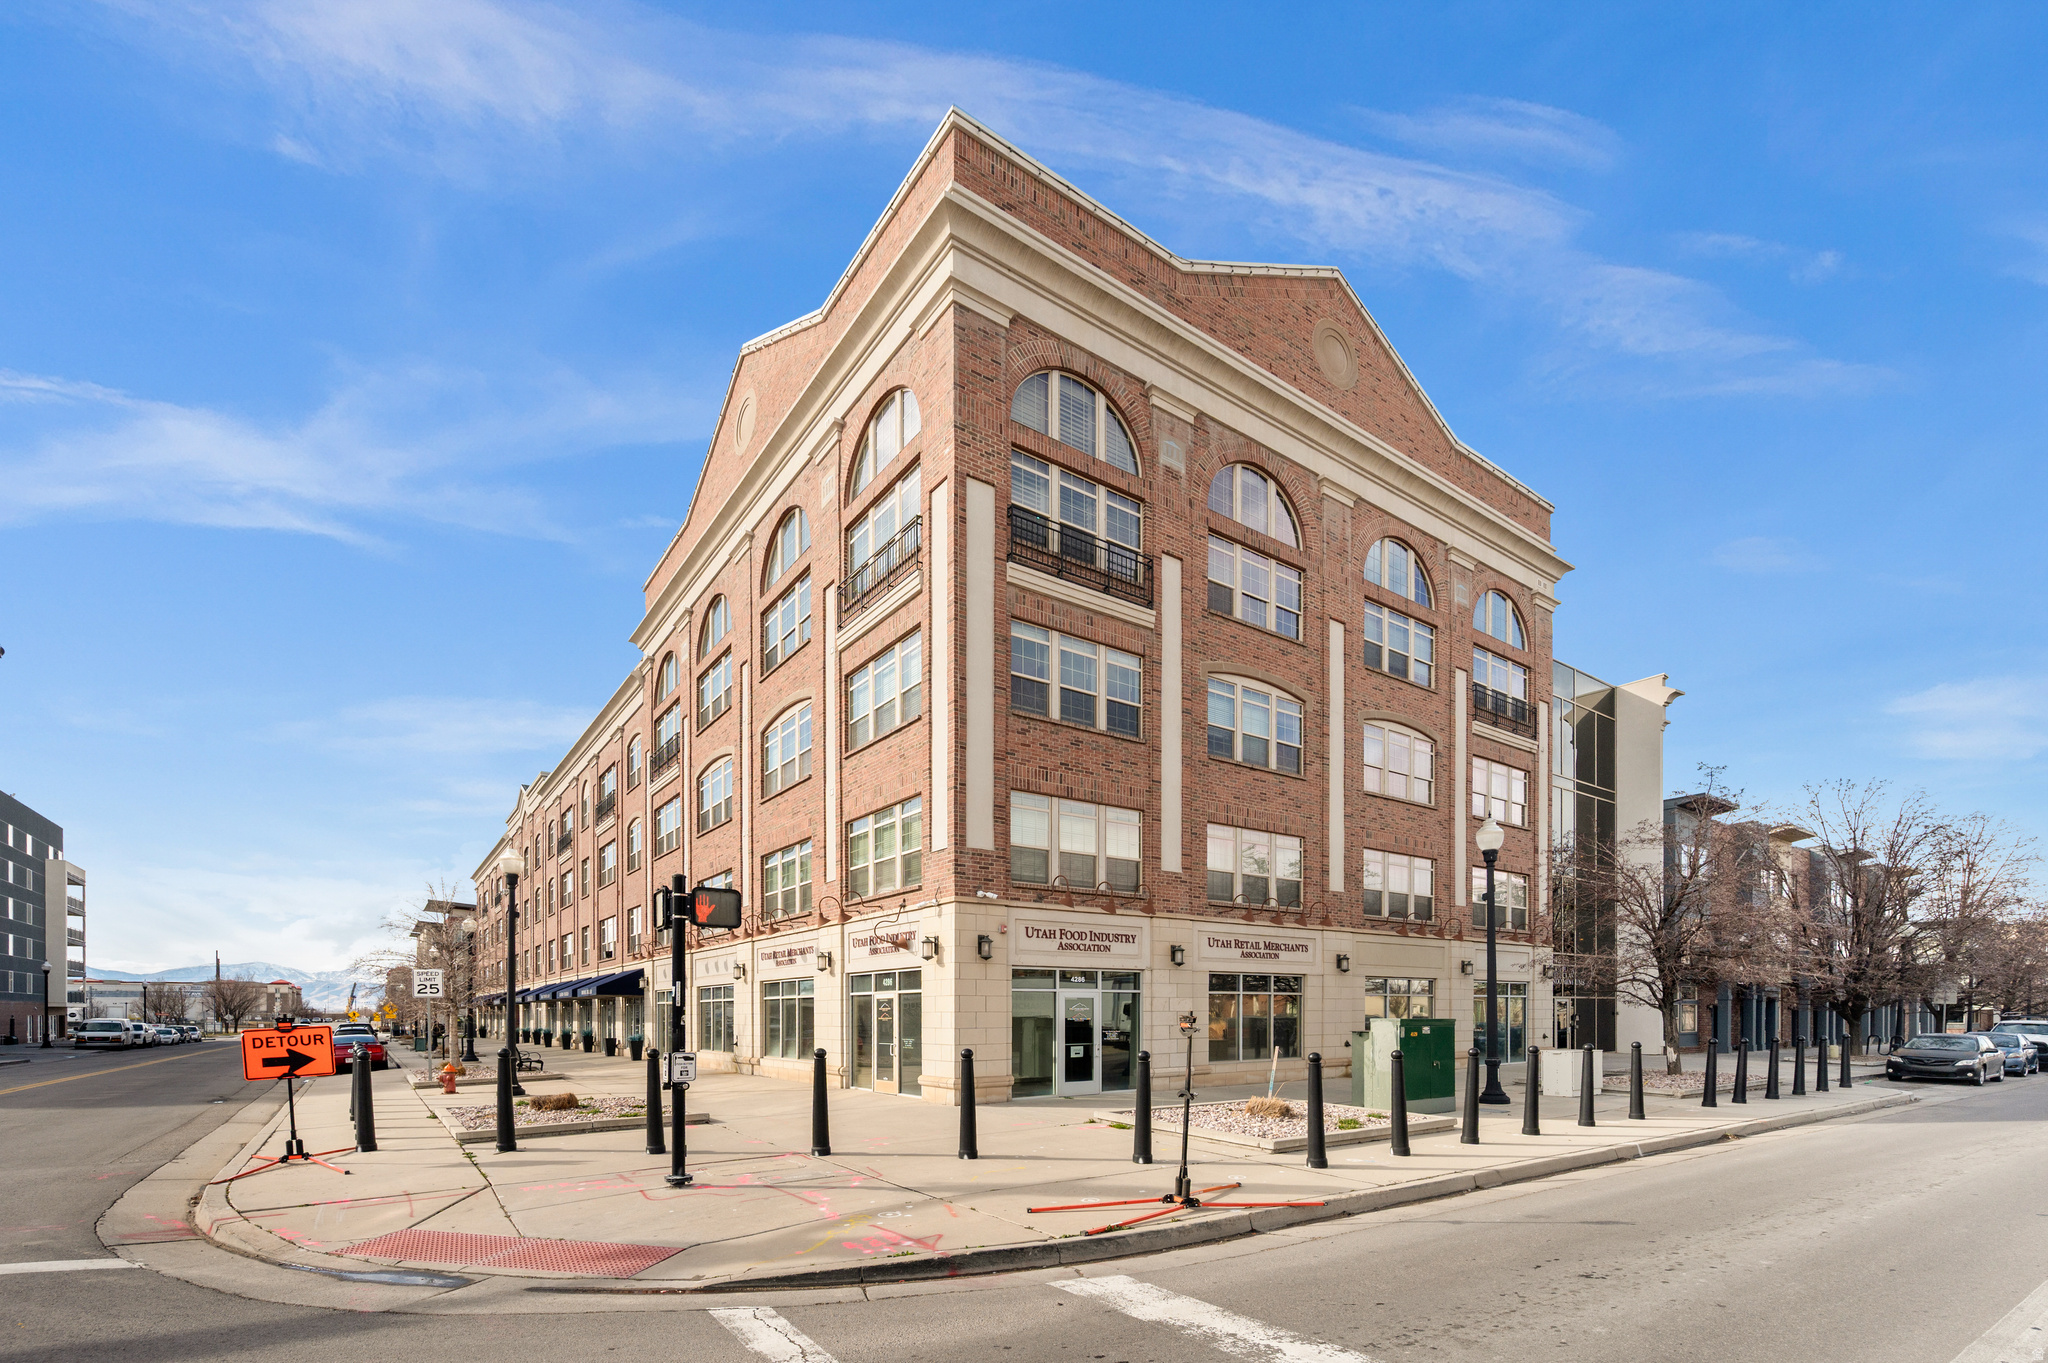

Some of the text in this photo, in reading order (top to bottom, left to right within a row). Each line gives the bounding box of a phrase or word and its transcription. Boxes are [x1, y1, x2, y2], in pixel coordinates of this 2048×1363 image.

[1025, 926, 1137, 944] UTAH FOOD INDUSTRY
[1057, 941, 1111, 953] ASSOCIATION
[1207, 937, 1309, 953] UTAH RETAIL MERCHANTS
[1240, 950, 1280, 960] ASSOCIATION
[417, 983, 440, 995] 25
[252, 1034, 325, 1050] DETOUR
